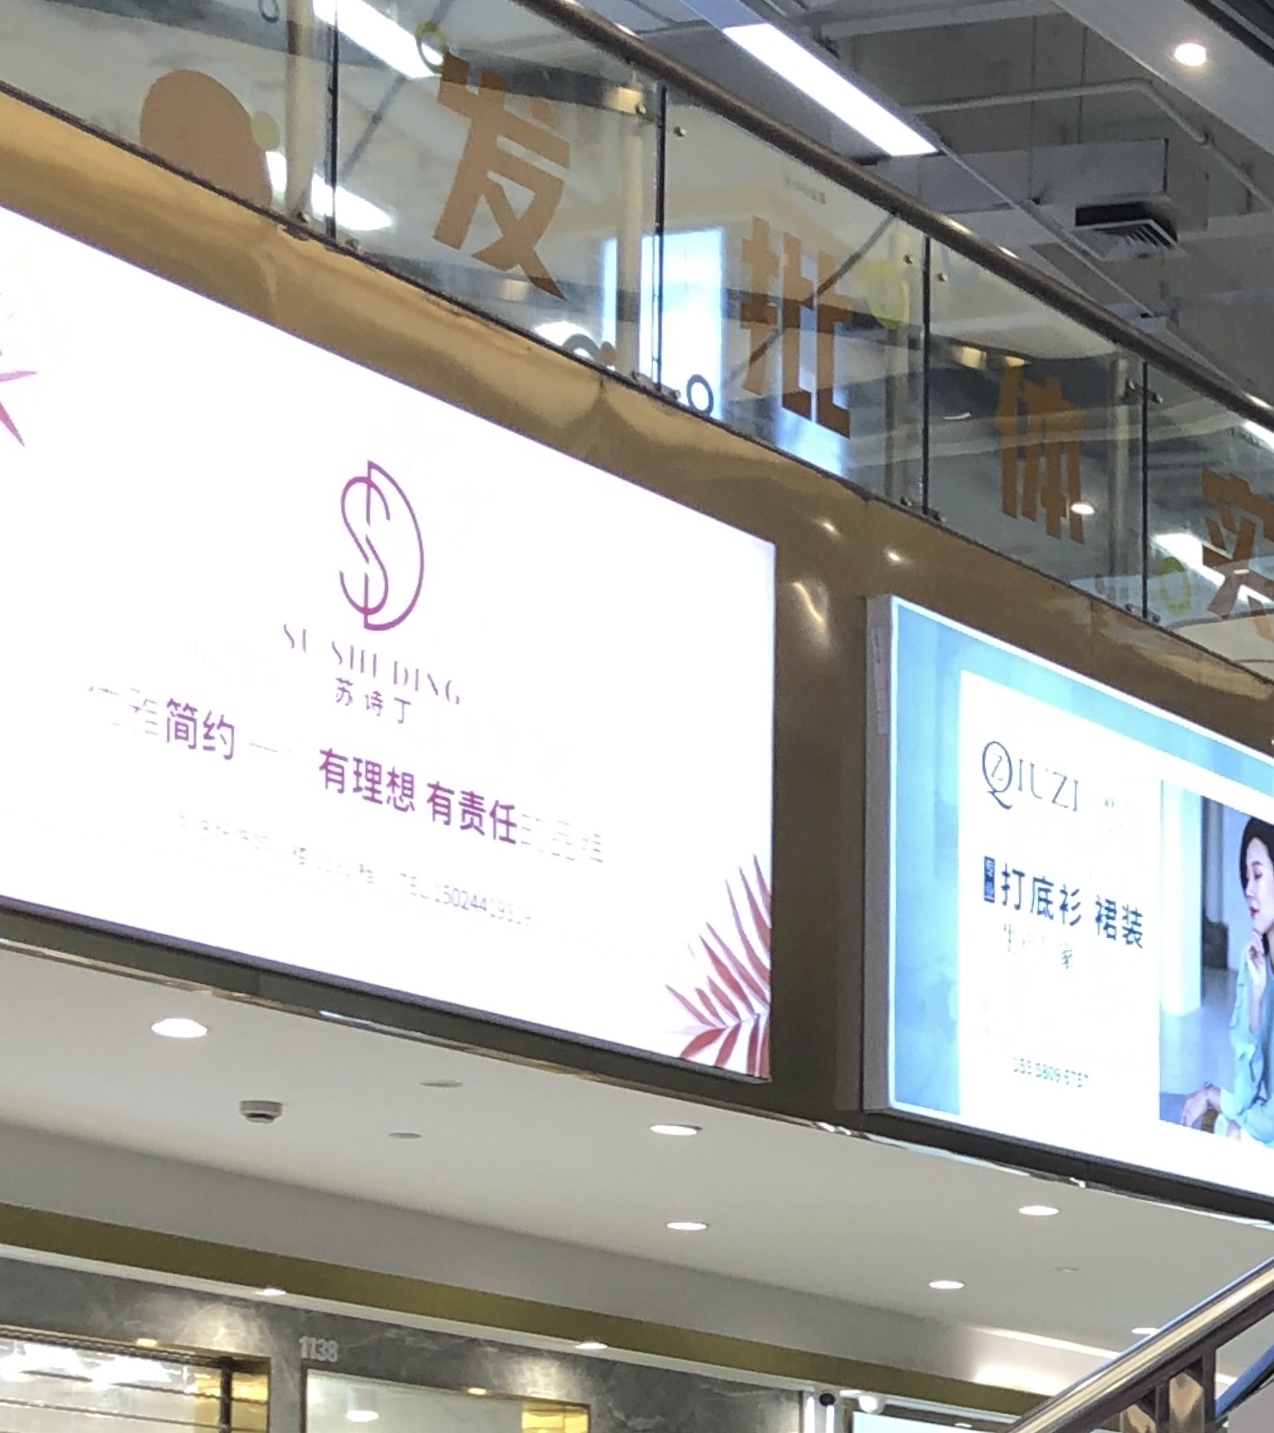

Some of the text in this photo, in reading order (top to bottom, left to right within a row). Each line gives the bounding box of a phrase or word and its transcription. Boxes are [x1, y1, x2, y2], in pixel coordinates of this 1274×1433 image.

[335, 677, 412, 724] 苏诗丁
[319, 747, 416, 813] 有理想
[1001, 863, 1082, 926] 打底衫
[1094, 894, 1144, 949] 裙装
[299, 1337, 339, 1362] 1138
